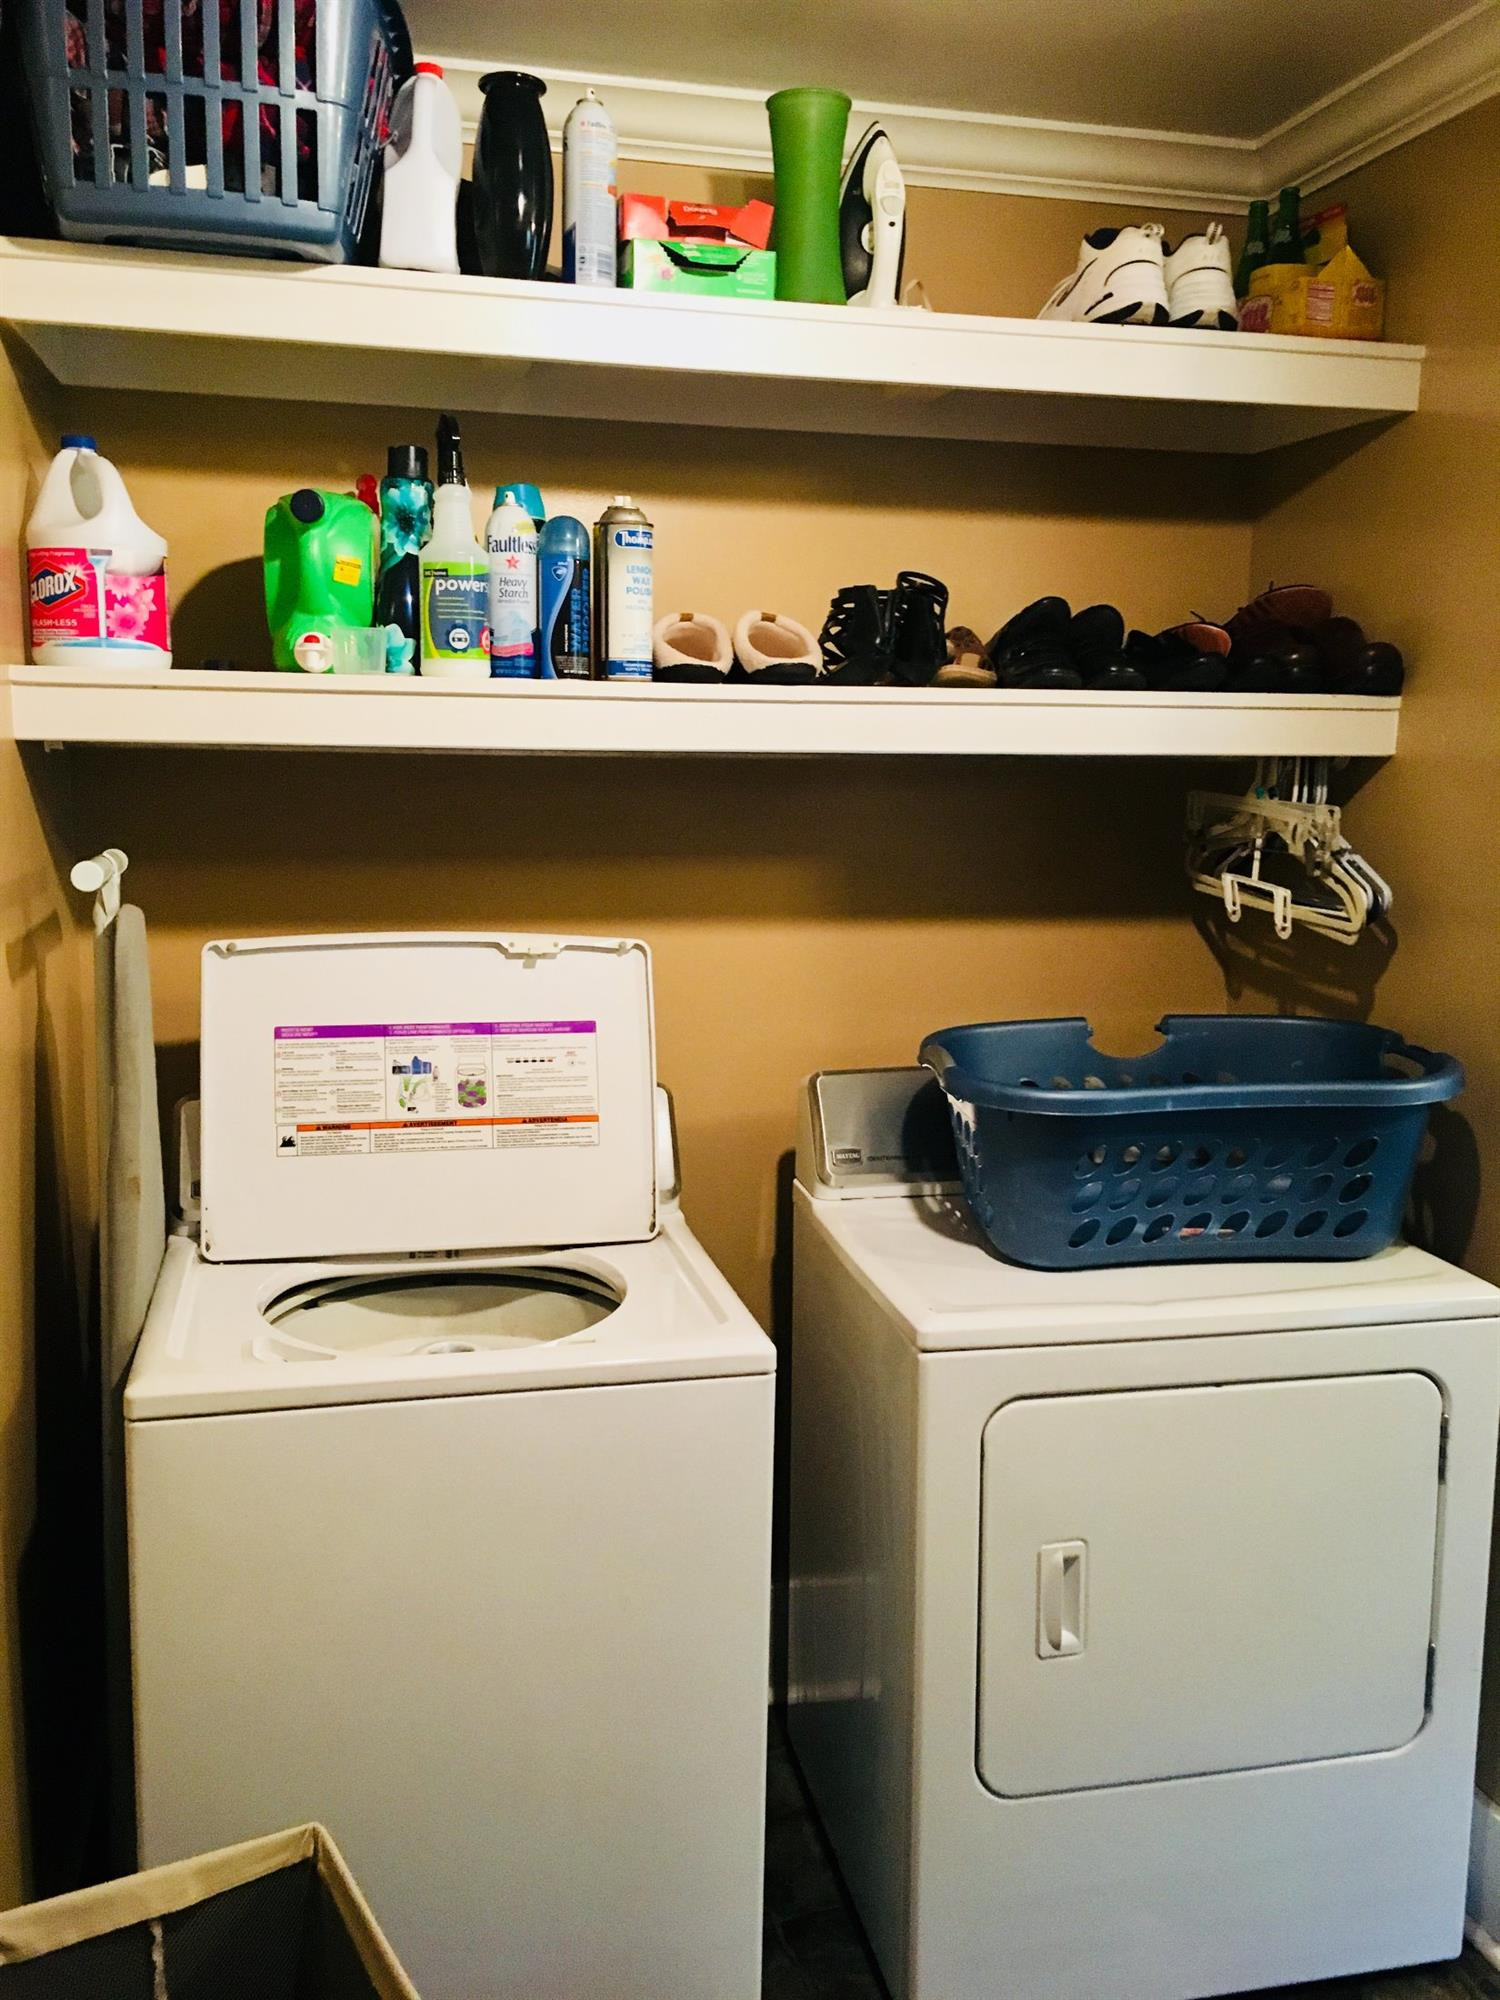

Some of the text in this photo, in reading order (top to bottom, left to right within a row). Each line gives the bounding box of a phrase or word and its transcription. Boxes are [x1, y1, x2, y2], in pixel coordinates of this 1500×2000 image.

[499, 576, 528, 588] Heavy
[499, 588, 529, 598] Starch
[570, 588, 581, 653] WATER
